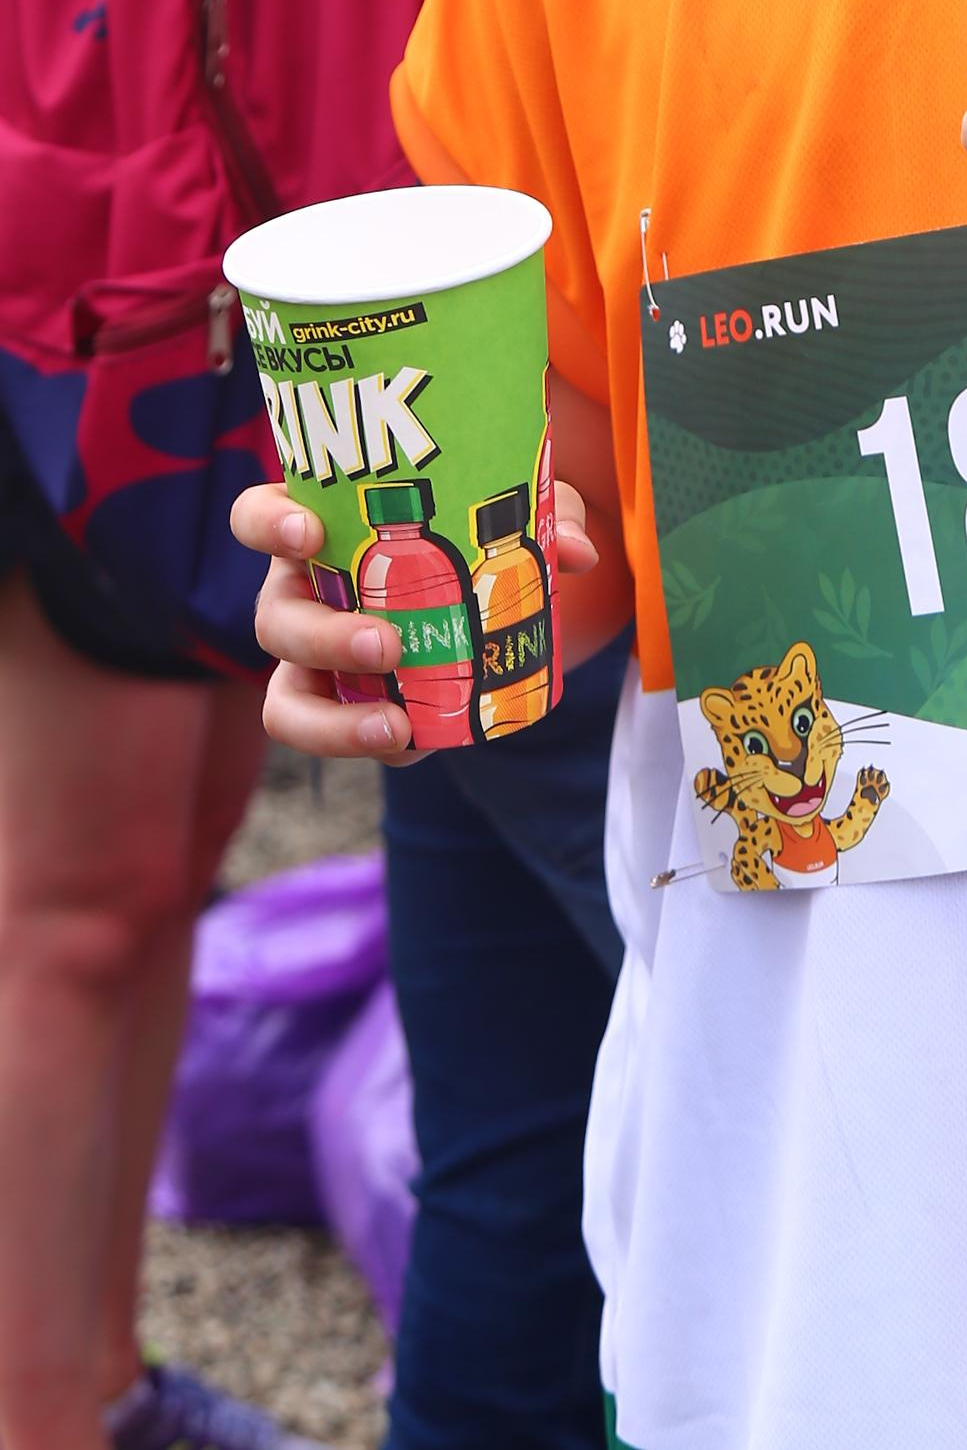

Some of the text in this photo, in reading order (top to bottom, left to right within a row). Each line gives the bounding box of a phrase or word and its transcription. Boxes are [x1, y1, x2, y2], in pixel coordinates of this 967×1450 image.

[293, 309, 416, 344] grink-city.ru
[700, 294, 839, 348] LEO.RUN
[264, 344, 355, 373] ВКУСЫ
